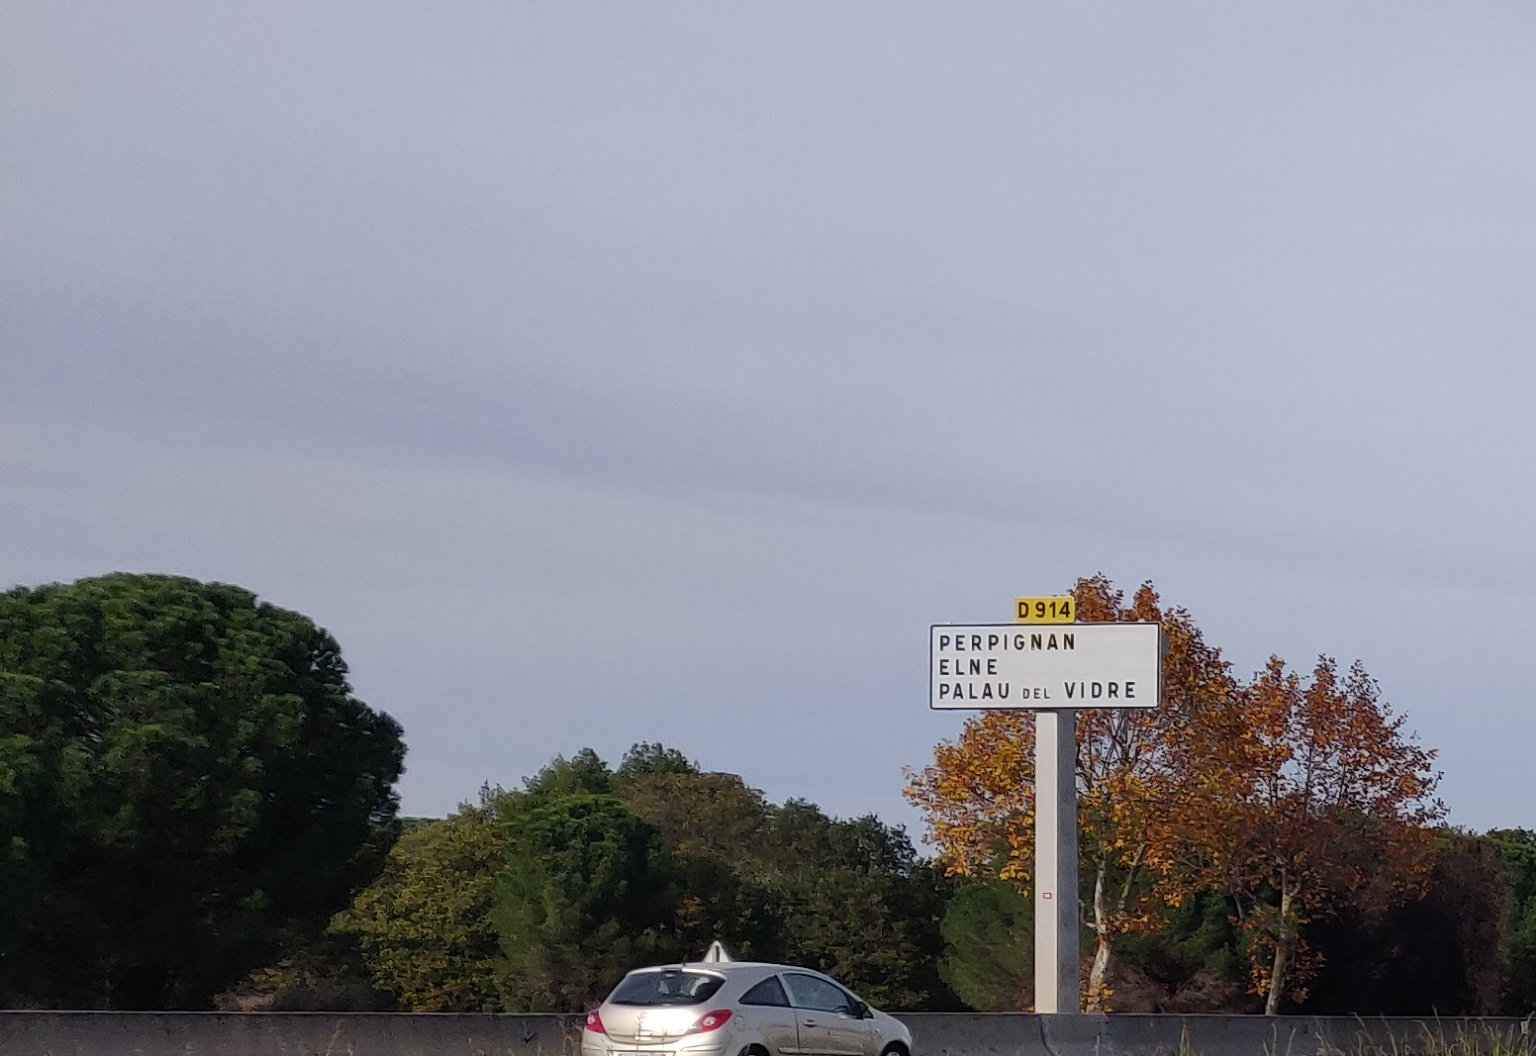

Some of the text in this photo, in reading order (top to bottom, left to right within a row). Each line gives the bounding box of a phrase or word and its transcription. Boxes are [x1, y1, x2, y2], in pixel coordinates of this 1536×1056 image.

[1018, 601, 1071, 618] D 914
[939, 633, 1076, 651] PERPIGNAN
[939, 659, 998, 676] ELNE
[939, 681, 1136, 700] PALAU DEL VIDRE
